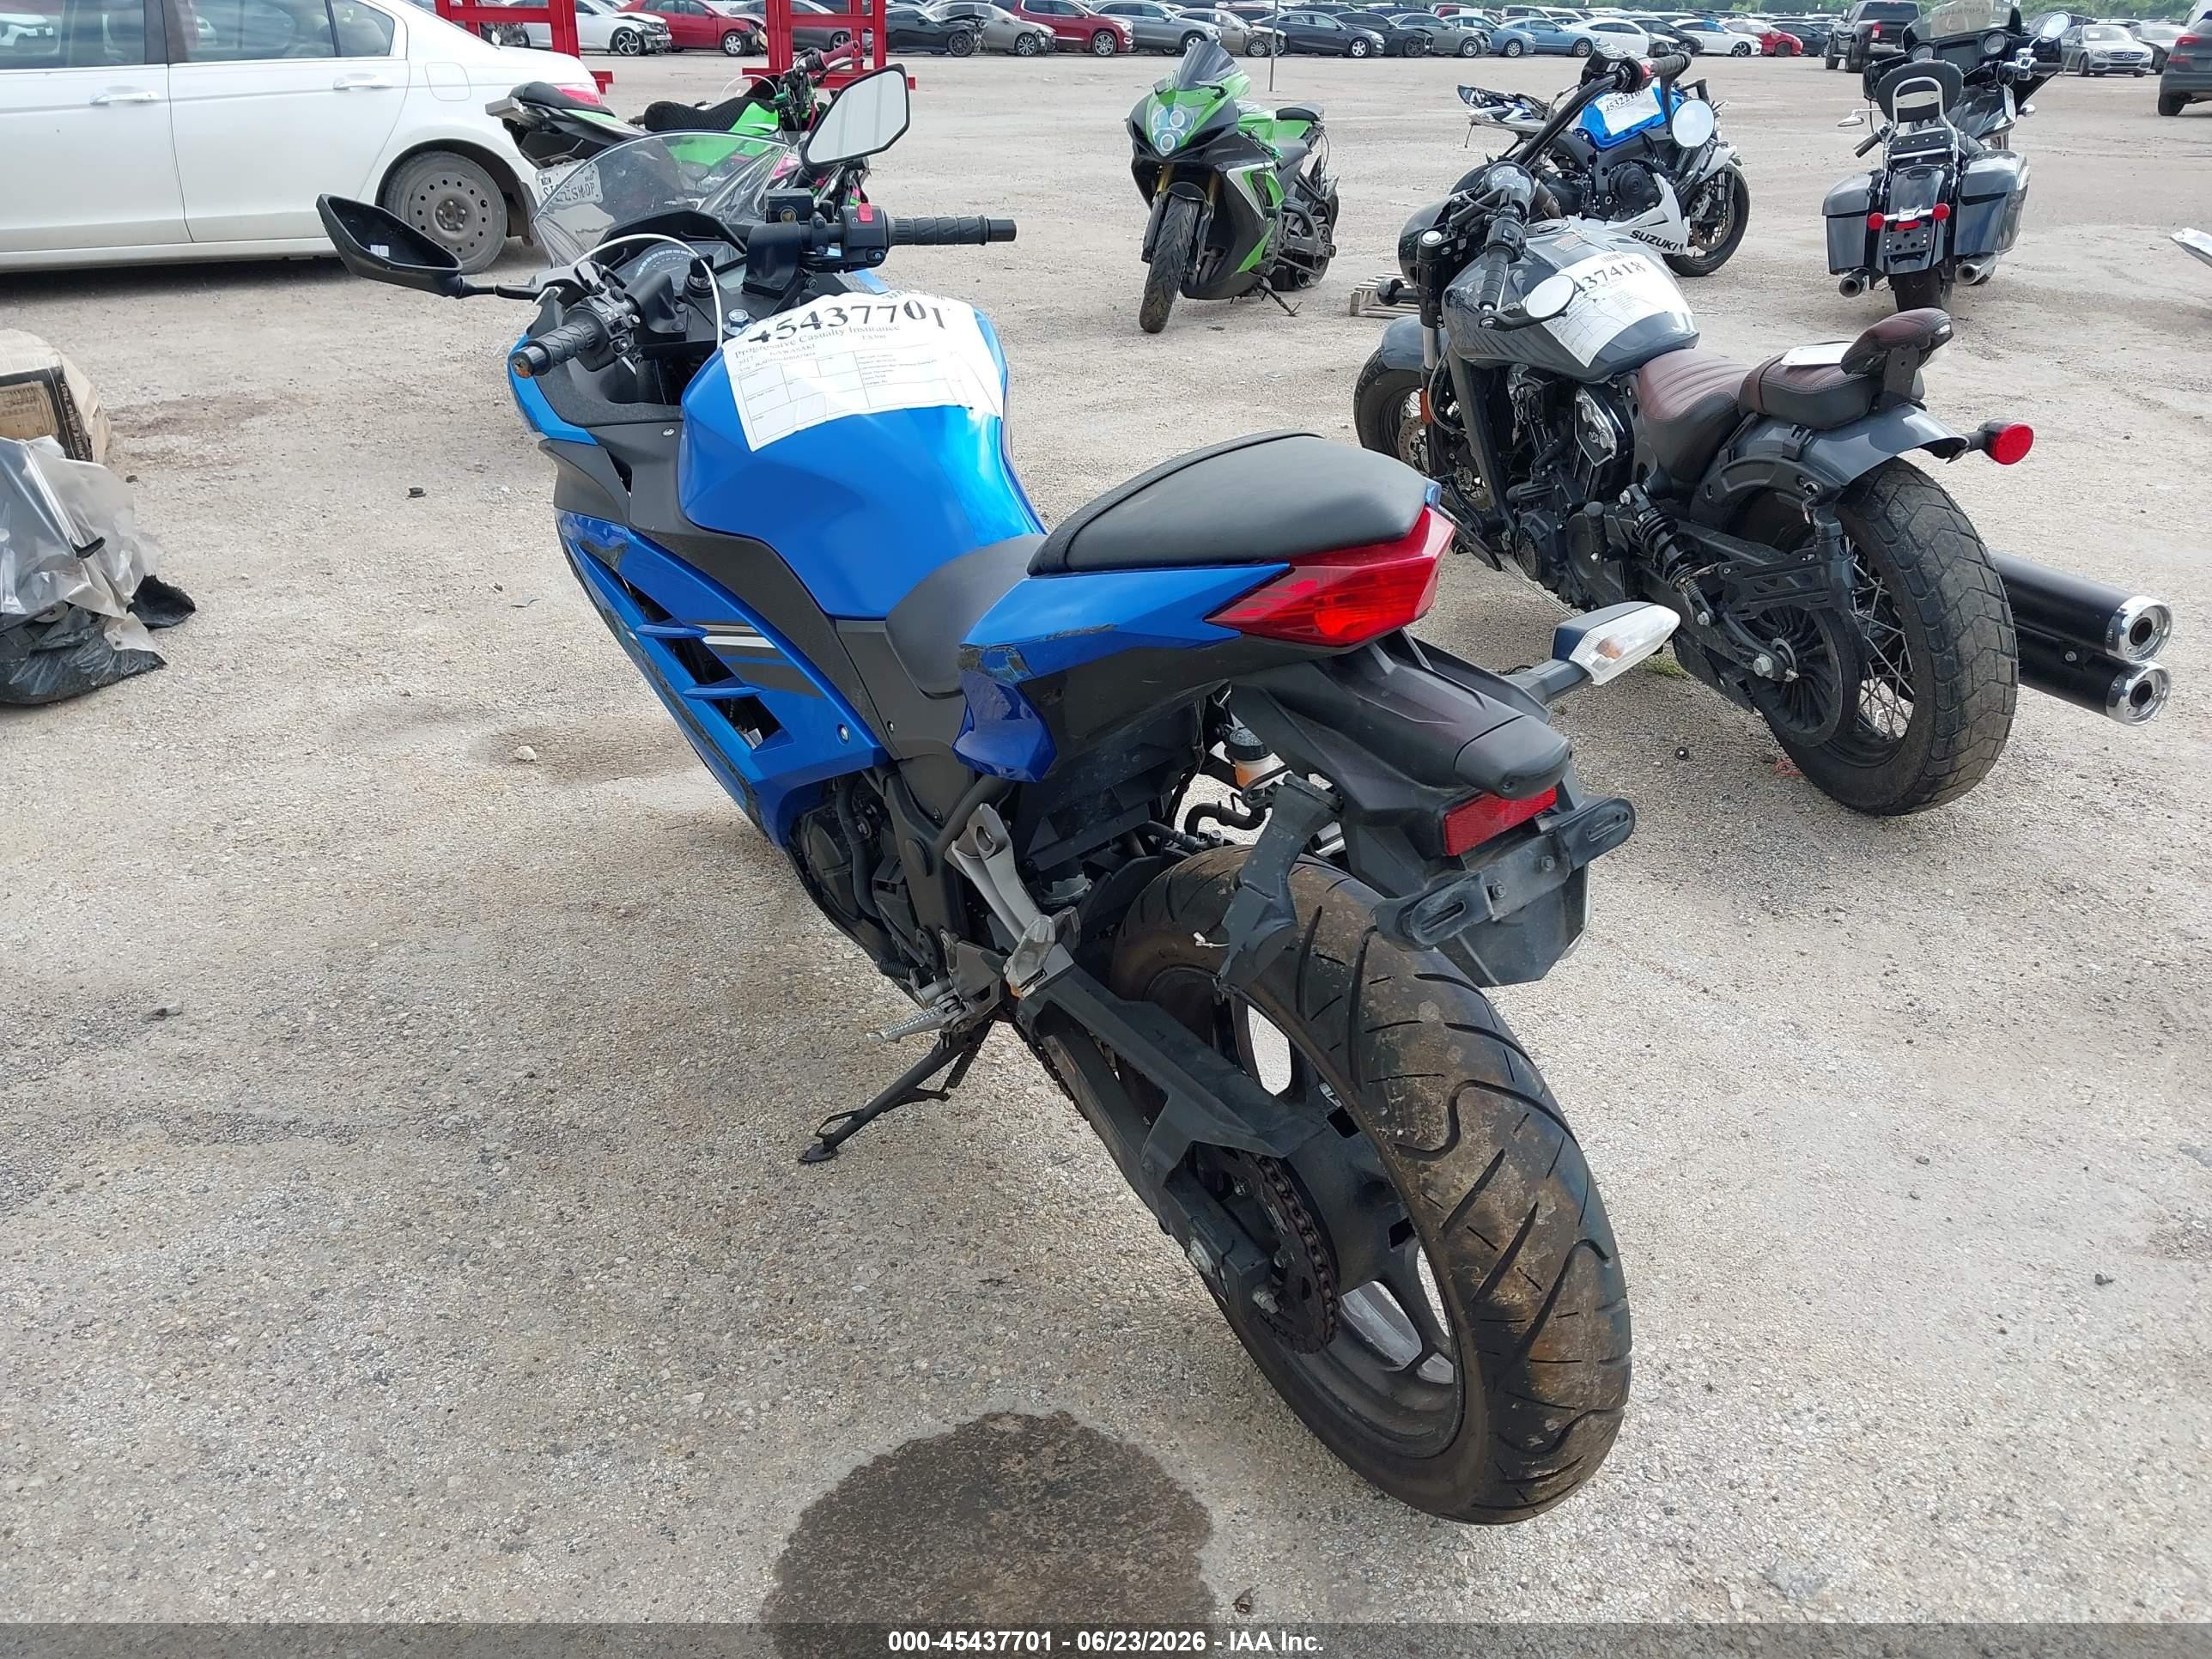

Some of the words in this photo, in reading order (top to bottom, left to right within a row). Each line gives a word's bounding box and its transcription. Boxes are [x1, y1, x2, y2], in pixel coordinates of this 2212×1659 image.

[1629, 229, 1679, 252] SUZUKI
[748, 300, 945, 343] 45437701
[735, 339, 797, 359] Progressive
[799, 325, 845, 343] Casualty
[848, 324, 901, 336] Insurance
[769, 343, 815, 356] KAWASAKI
